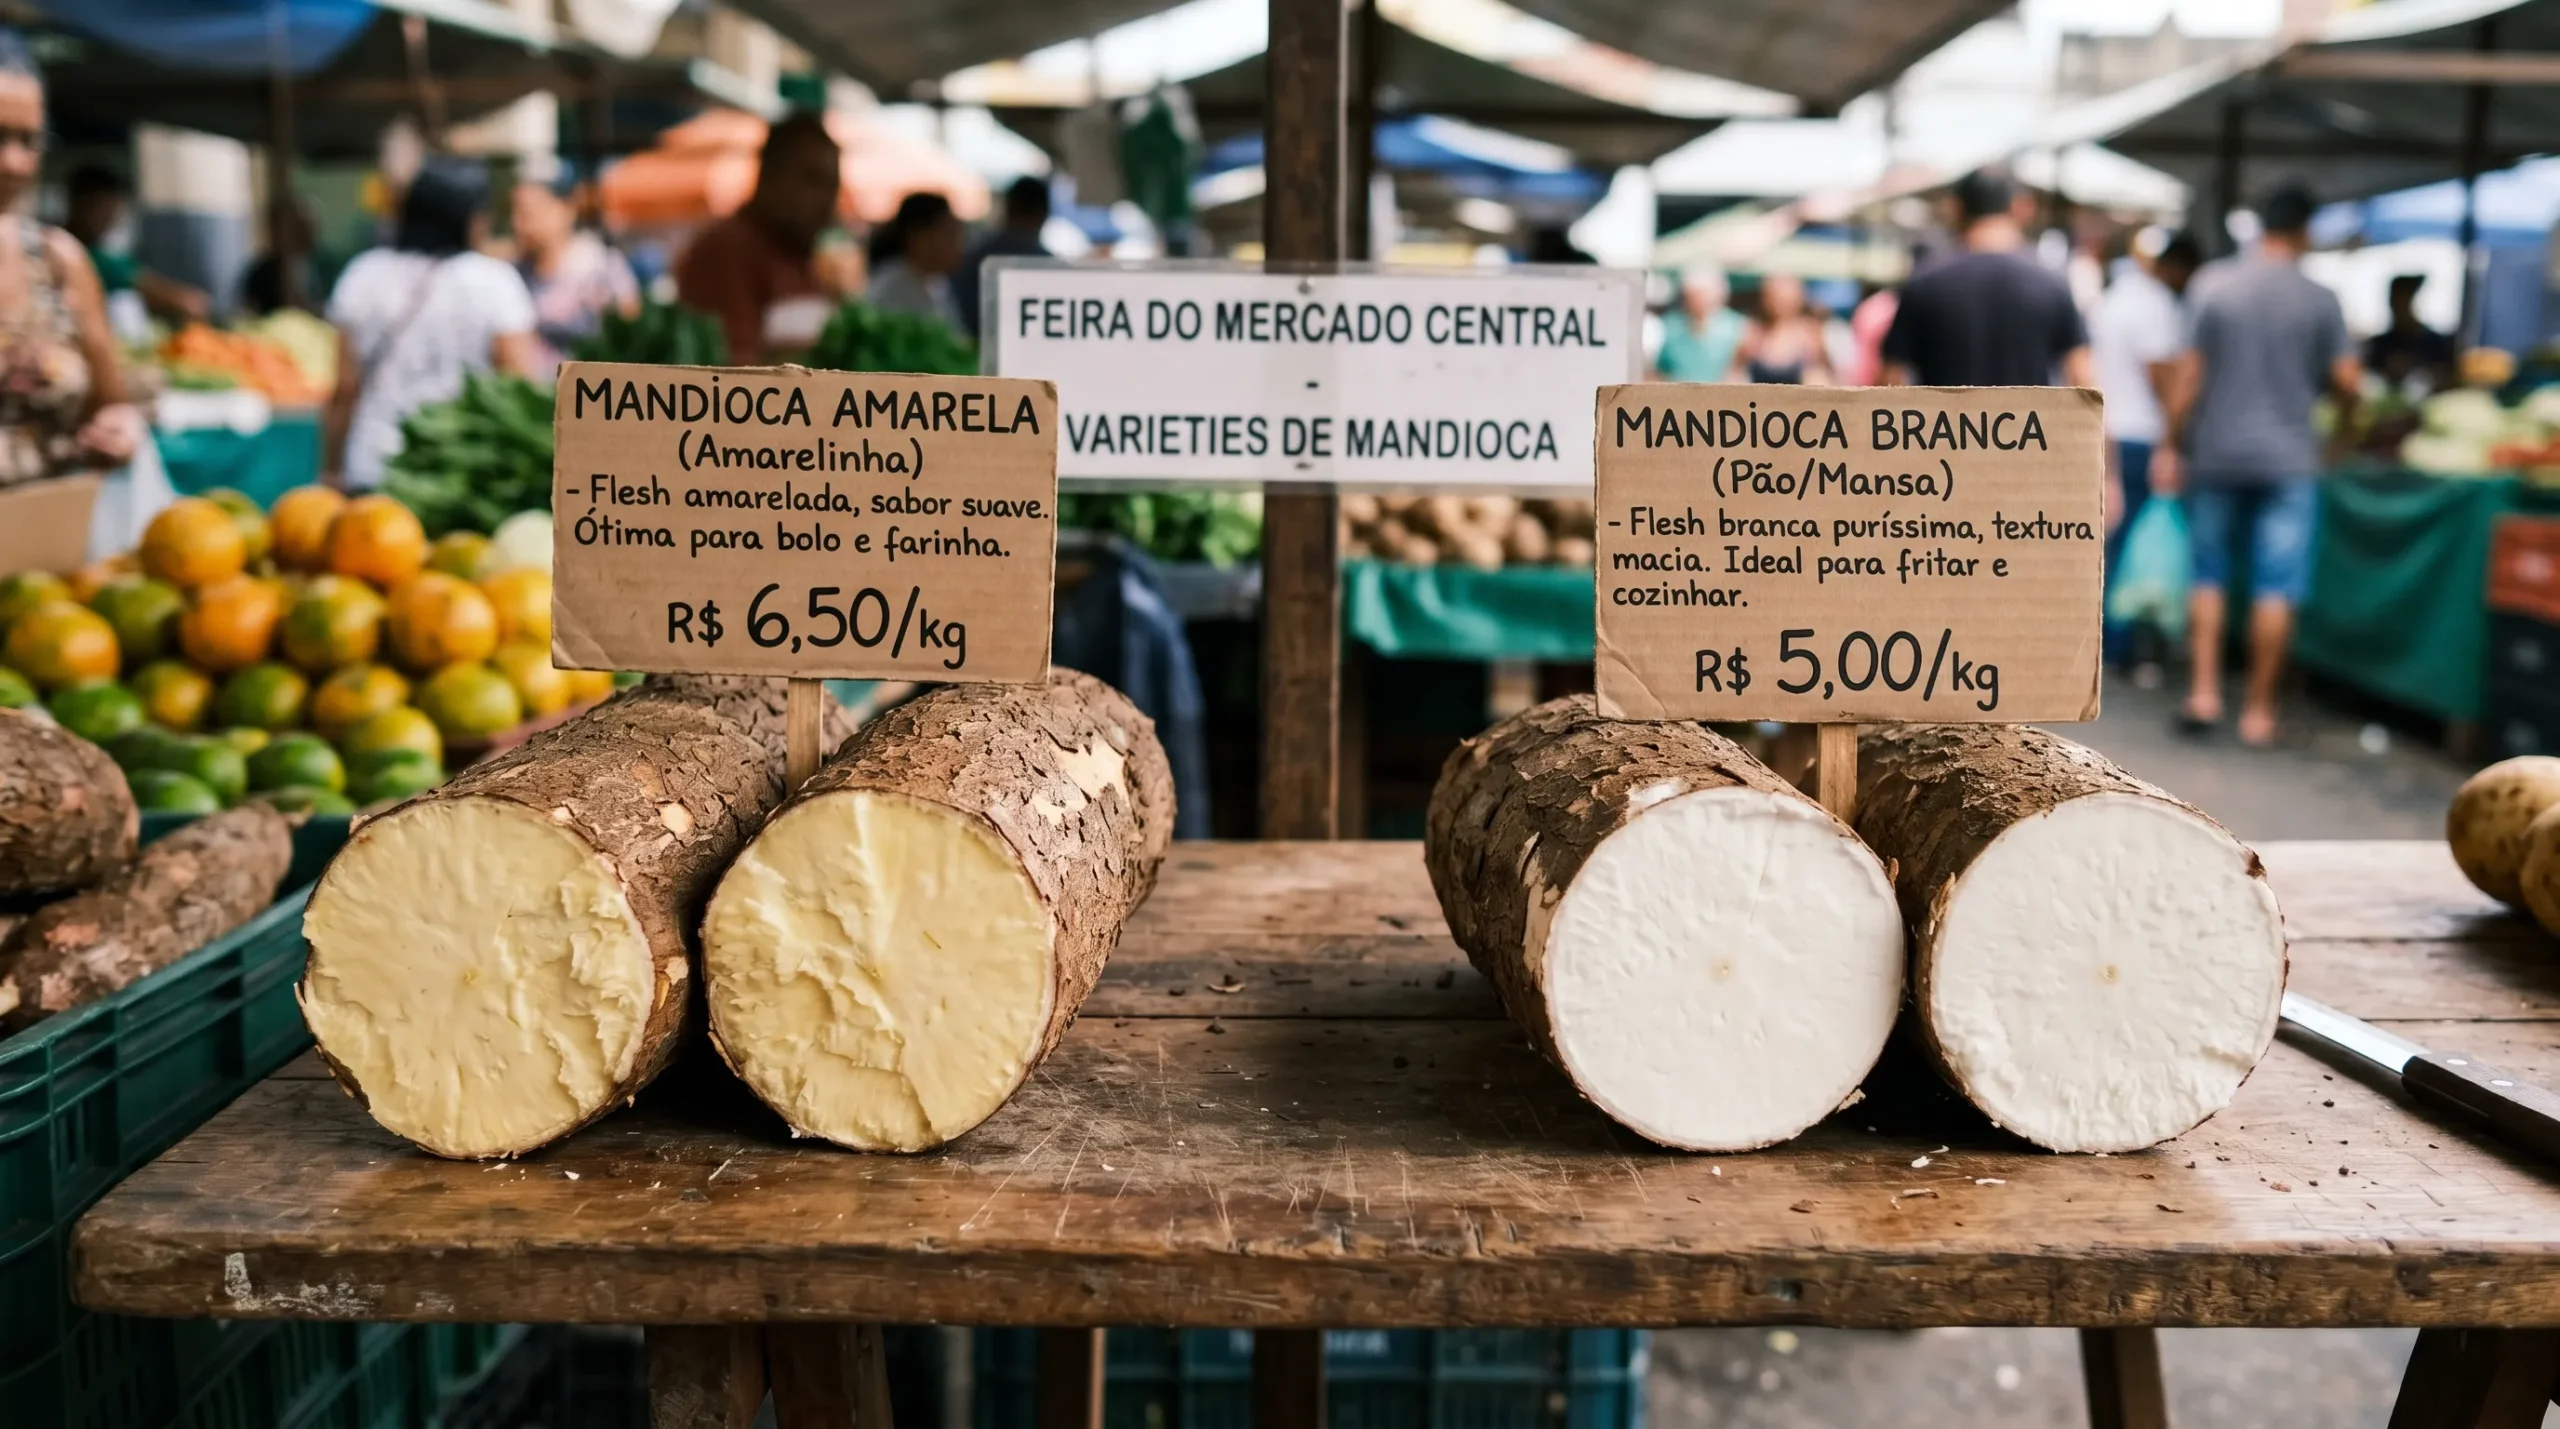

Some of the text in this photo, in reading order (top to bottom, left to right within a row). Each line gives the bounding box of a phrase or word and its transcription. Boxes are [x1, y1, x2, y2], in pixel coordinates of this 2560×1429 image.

[1019, 298, 1607, 347] FEIRA DO MERCADO CENTRAL
[831, 387, 1040, 436] AMARELA
[1871, 408, 2048, 451] BRANCA
[678, 429, 923, 481] (Amarelinha)
[1065, 413, 1559, 460] VARIETIES DE MANDIOCA
[590, 473, 671, 507] Flesh
[684, 480, 861, 518] amarelada,
[870, 485, 953, 516] sabor
[961, 498, 1049, 519] suave.
[1712, 456, 1954, 502] (Pão/Mansa)
[574, 506, 1011, 563] Ótima para bolo e farinha.
[1630, 506, 1705, 536] Flesh
[1718, 507, 1821, 538] branca
[1833, 509, 1984, 547] puríssima,
[1991, 510, 2095, 540] textura
[1612, 544, 2009, 585] macia. Ideal para fritar e
[1612, 578, 1749, 608] cozinhar.
[667, 582, 967, 671] R$ 6,50/kg
[1695, 628, 1999, 712] R$ 5,00/kg
